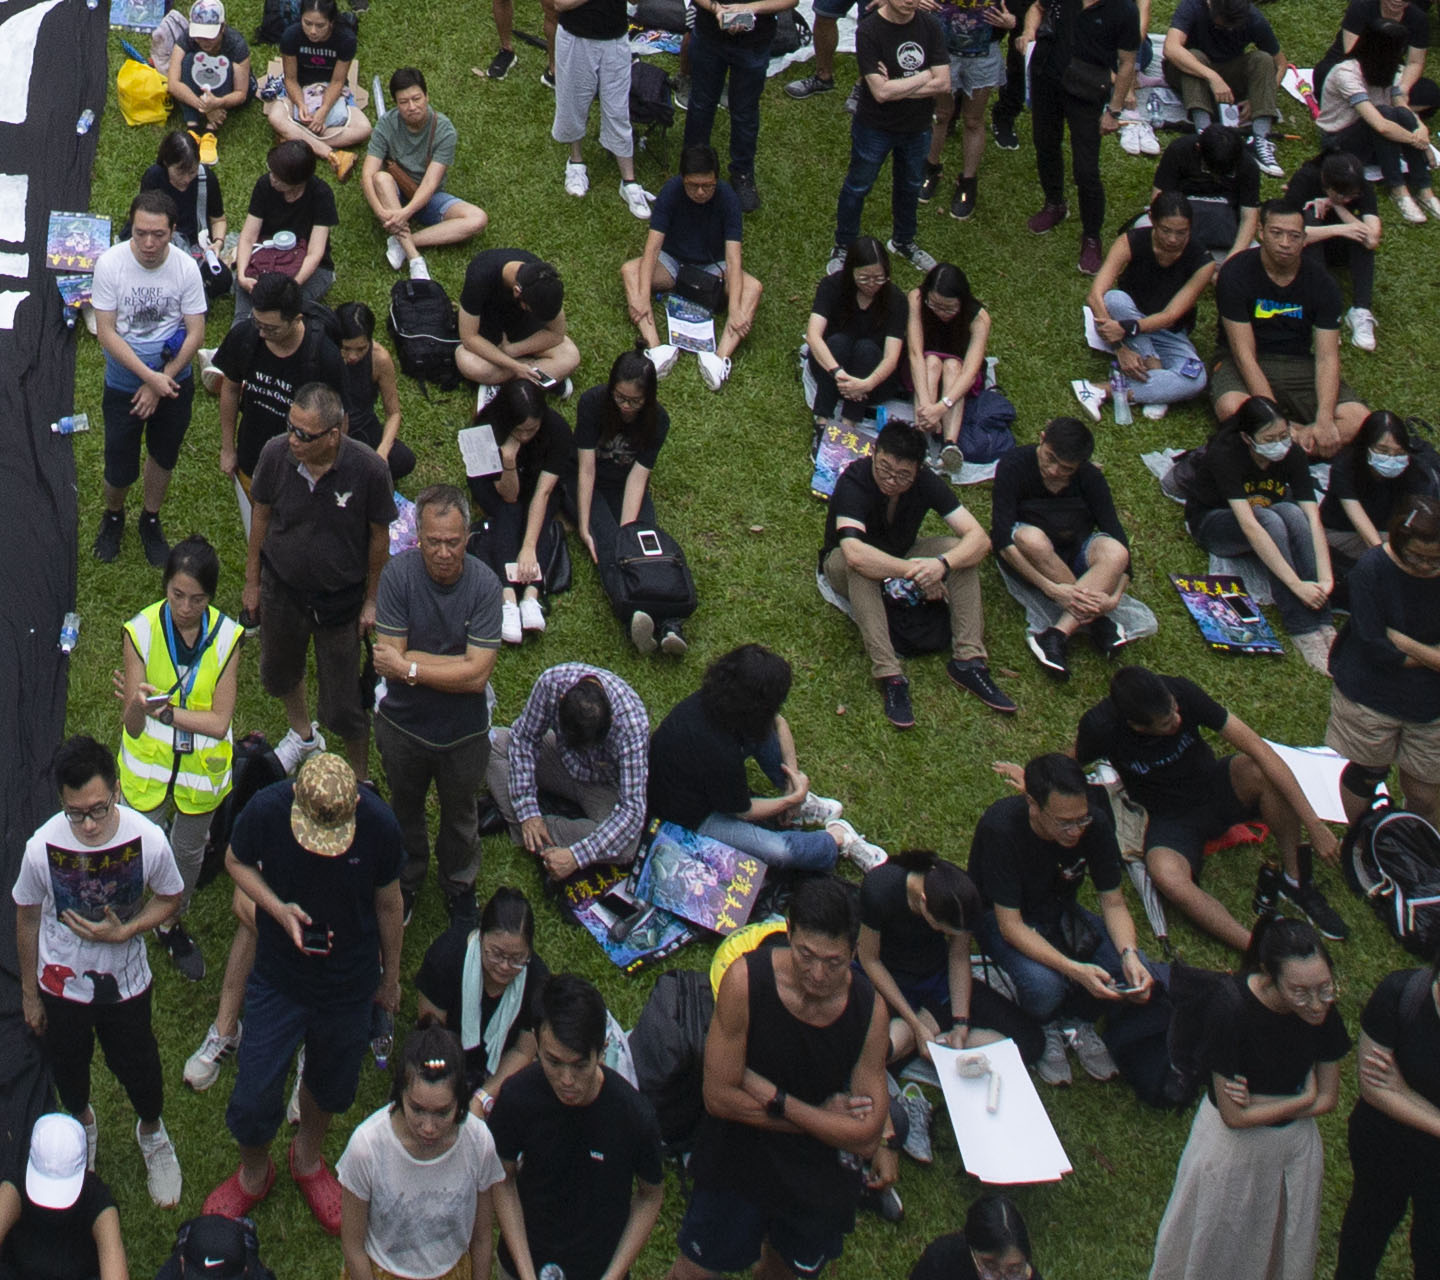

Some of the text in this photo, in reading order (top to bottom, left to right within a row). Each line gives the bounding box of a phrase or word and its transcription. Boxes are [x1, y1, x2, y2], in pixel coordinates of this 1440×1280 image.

[130, 286, 164, 298] MORE
[123, 296, 171, 309] RESPECT
[255, 370, 293, 393] WE ARE
[828, 424, 871, 457] 守護未
